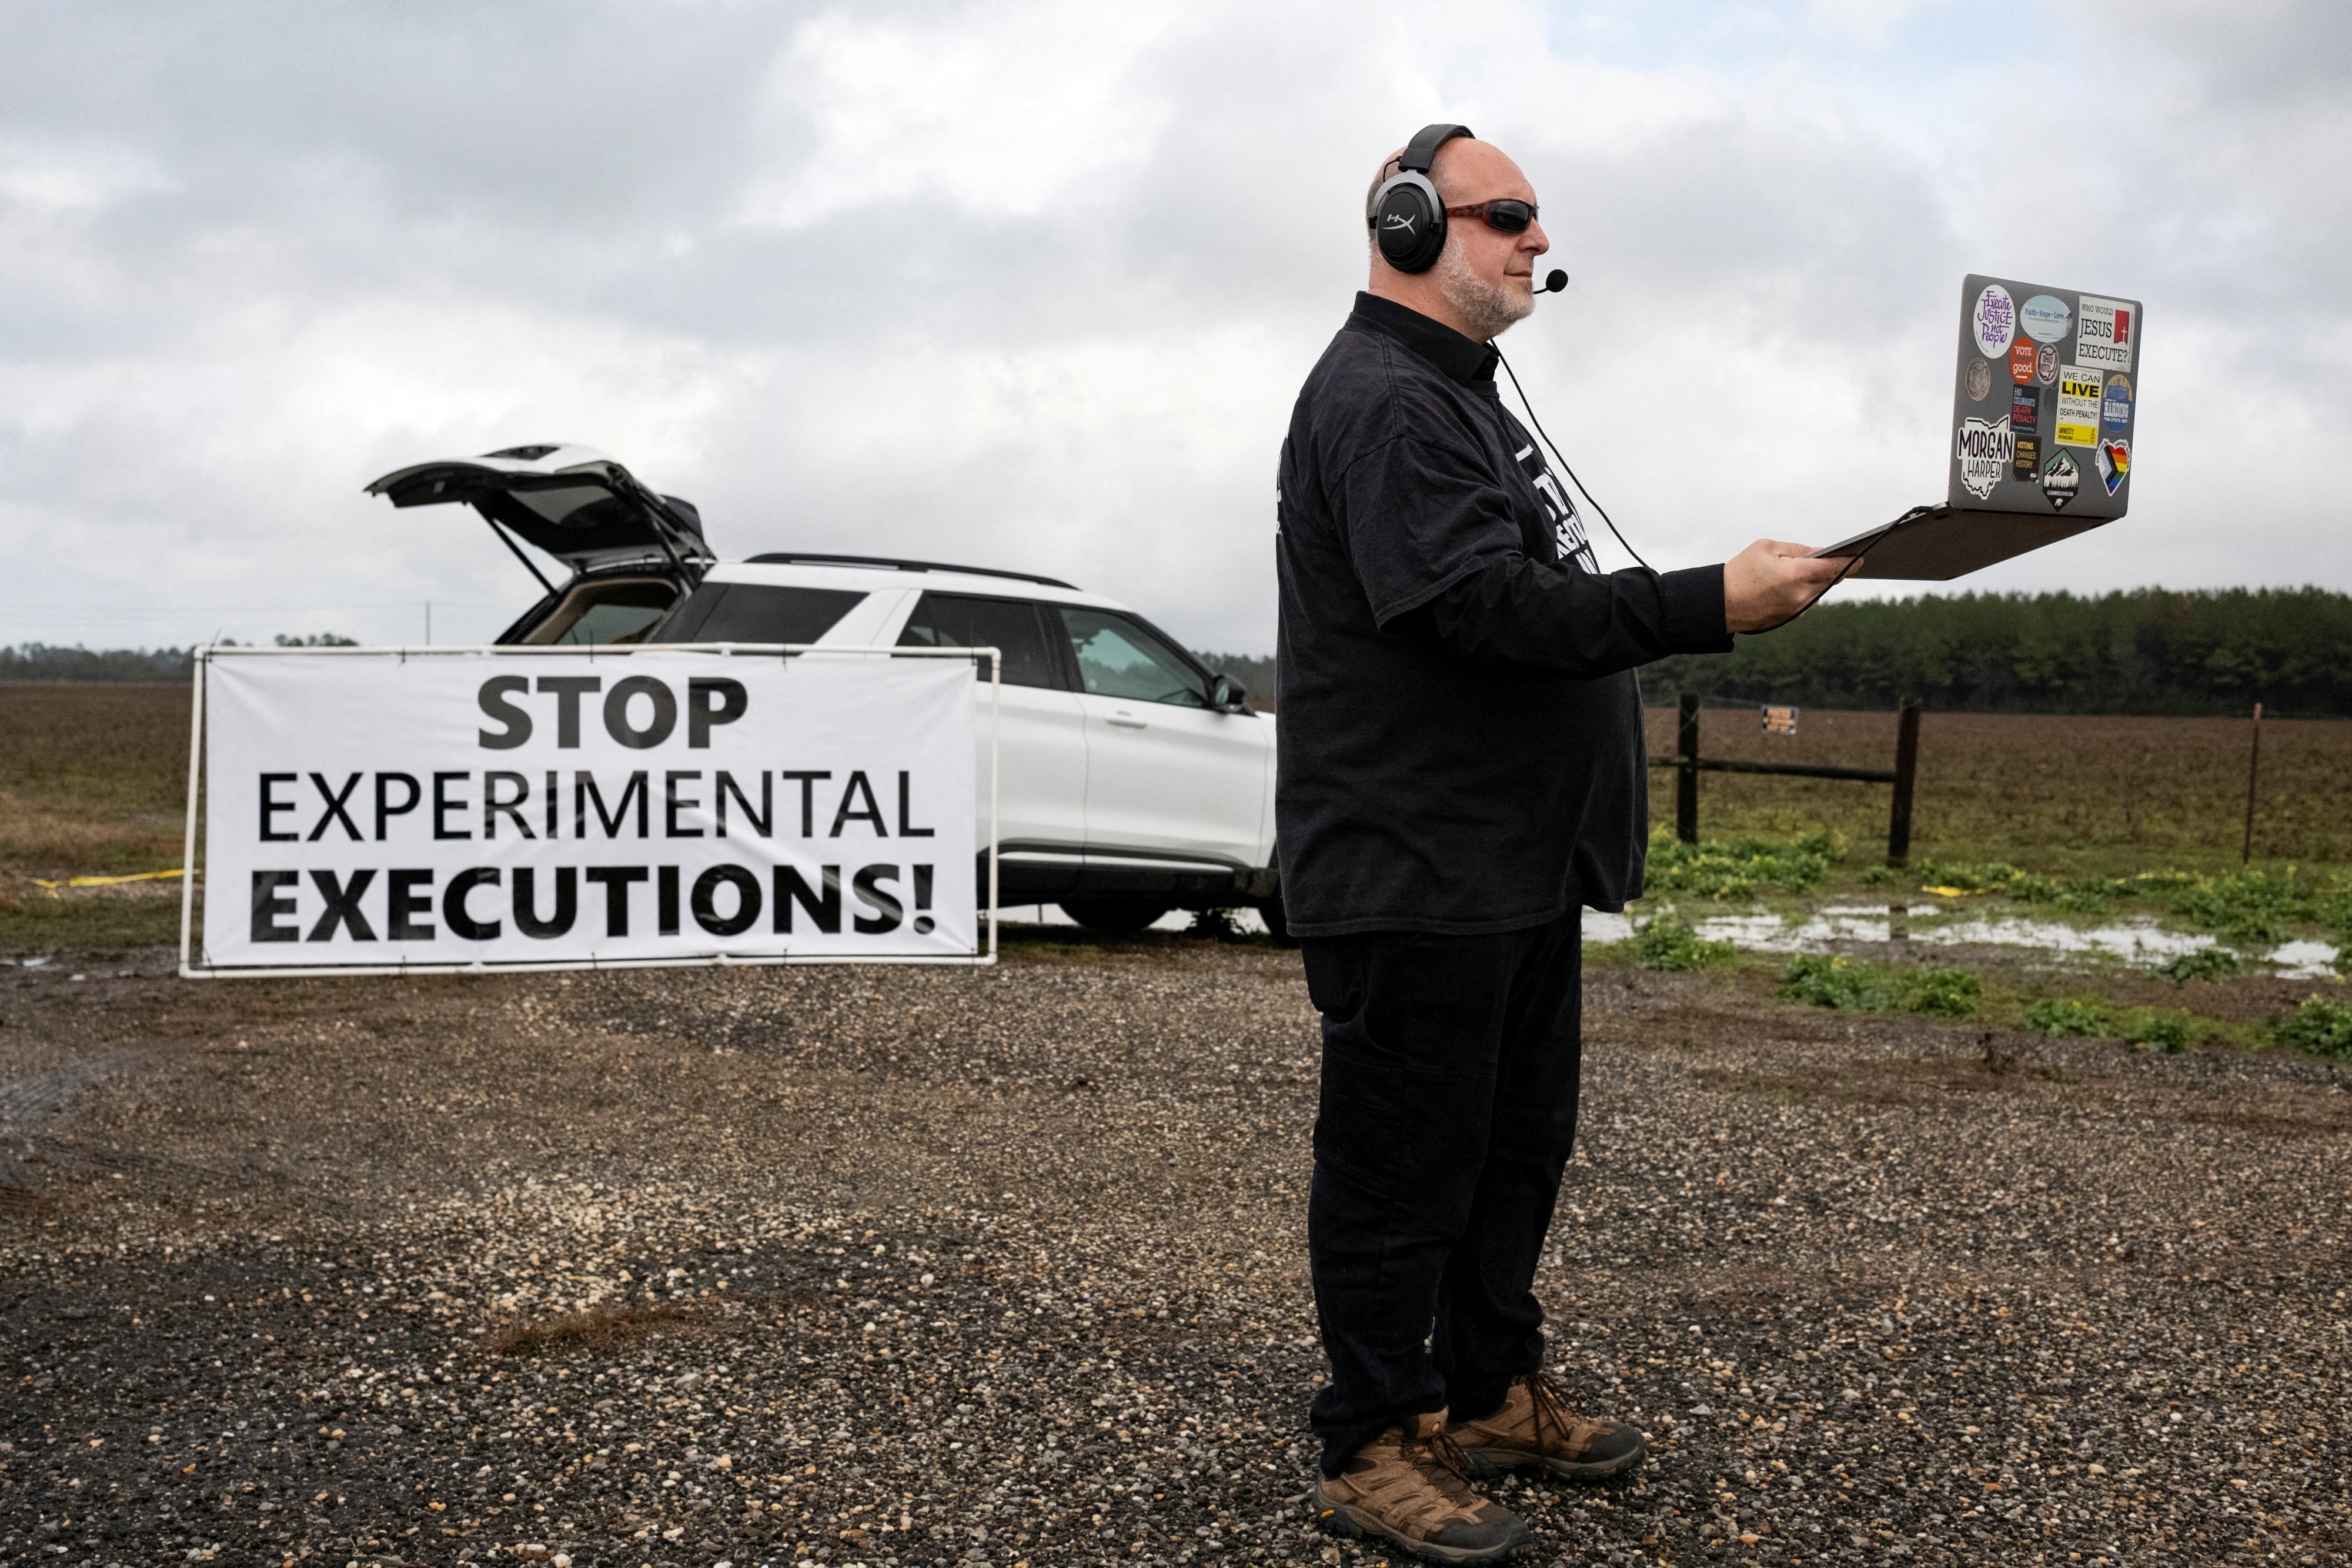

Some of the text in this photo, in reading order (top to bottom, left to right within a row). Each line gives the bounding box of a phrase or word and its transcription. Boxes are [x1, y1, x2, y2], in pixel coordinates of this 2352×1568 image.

[1986, 290, 2012, 310] Execute
[2082, 304, 2113, 316] WHO WOULD
[1991, 324, 2009, 333] not
[2079, 318, 2112, 338] JESUS
[1982, 323, 2007, 348] People
[2014, 346, 2032, 356] VOTE
[2079, 343, 2127, 363] EXECUTE?
[2043, 355, 2052, 364] OHIO
[2013, 363, 2033, 375] good
[2063, 372, 2100, 383] WE CAN
[2062, 381, 2099, 398] LIVE
[2013, 396, 2035, 407] COLORADO'S
[2062, 397, 2086, 406] WITHOUT
[2013, 405, 2031, 414] DEATH
[2060, 408, 2097, 419] DEATH PENALTY!
[2012, 413, 2036, 424] PENALTY
[2059, 427, 2074, 435] AMNESTY
[1959, 429, 2013, 460] MORGAN
[2017, 441, 2033, 450] VOTING
[2016, 450, 2036, 460] CHANGES
[1967, 459, 2000, 479] HARPER
[477, 674, 749, 750] STOP
[259, 770, 935, 842] EXPERIMENTAL
[249, 863, 936, 942] EXECUTIONS!
